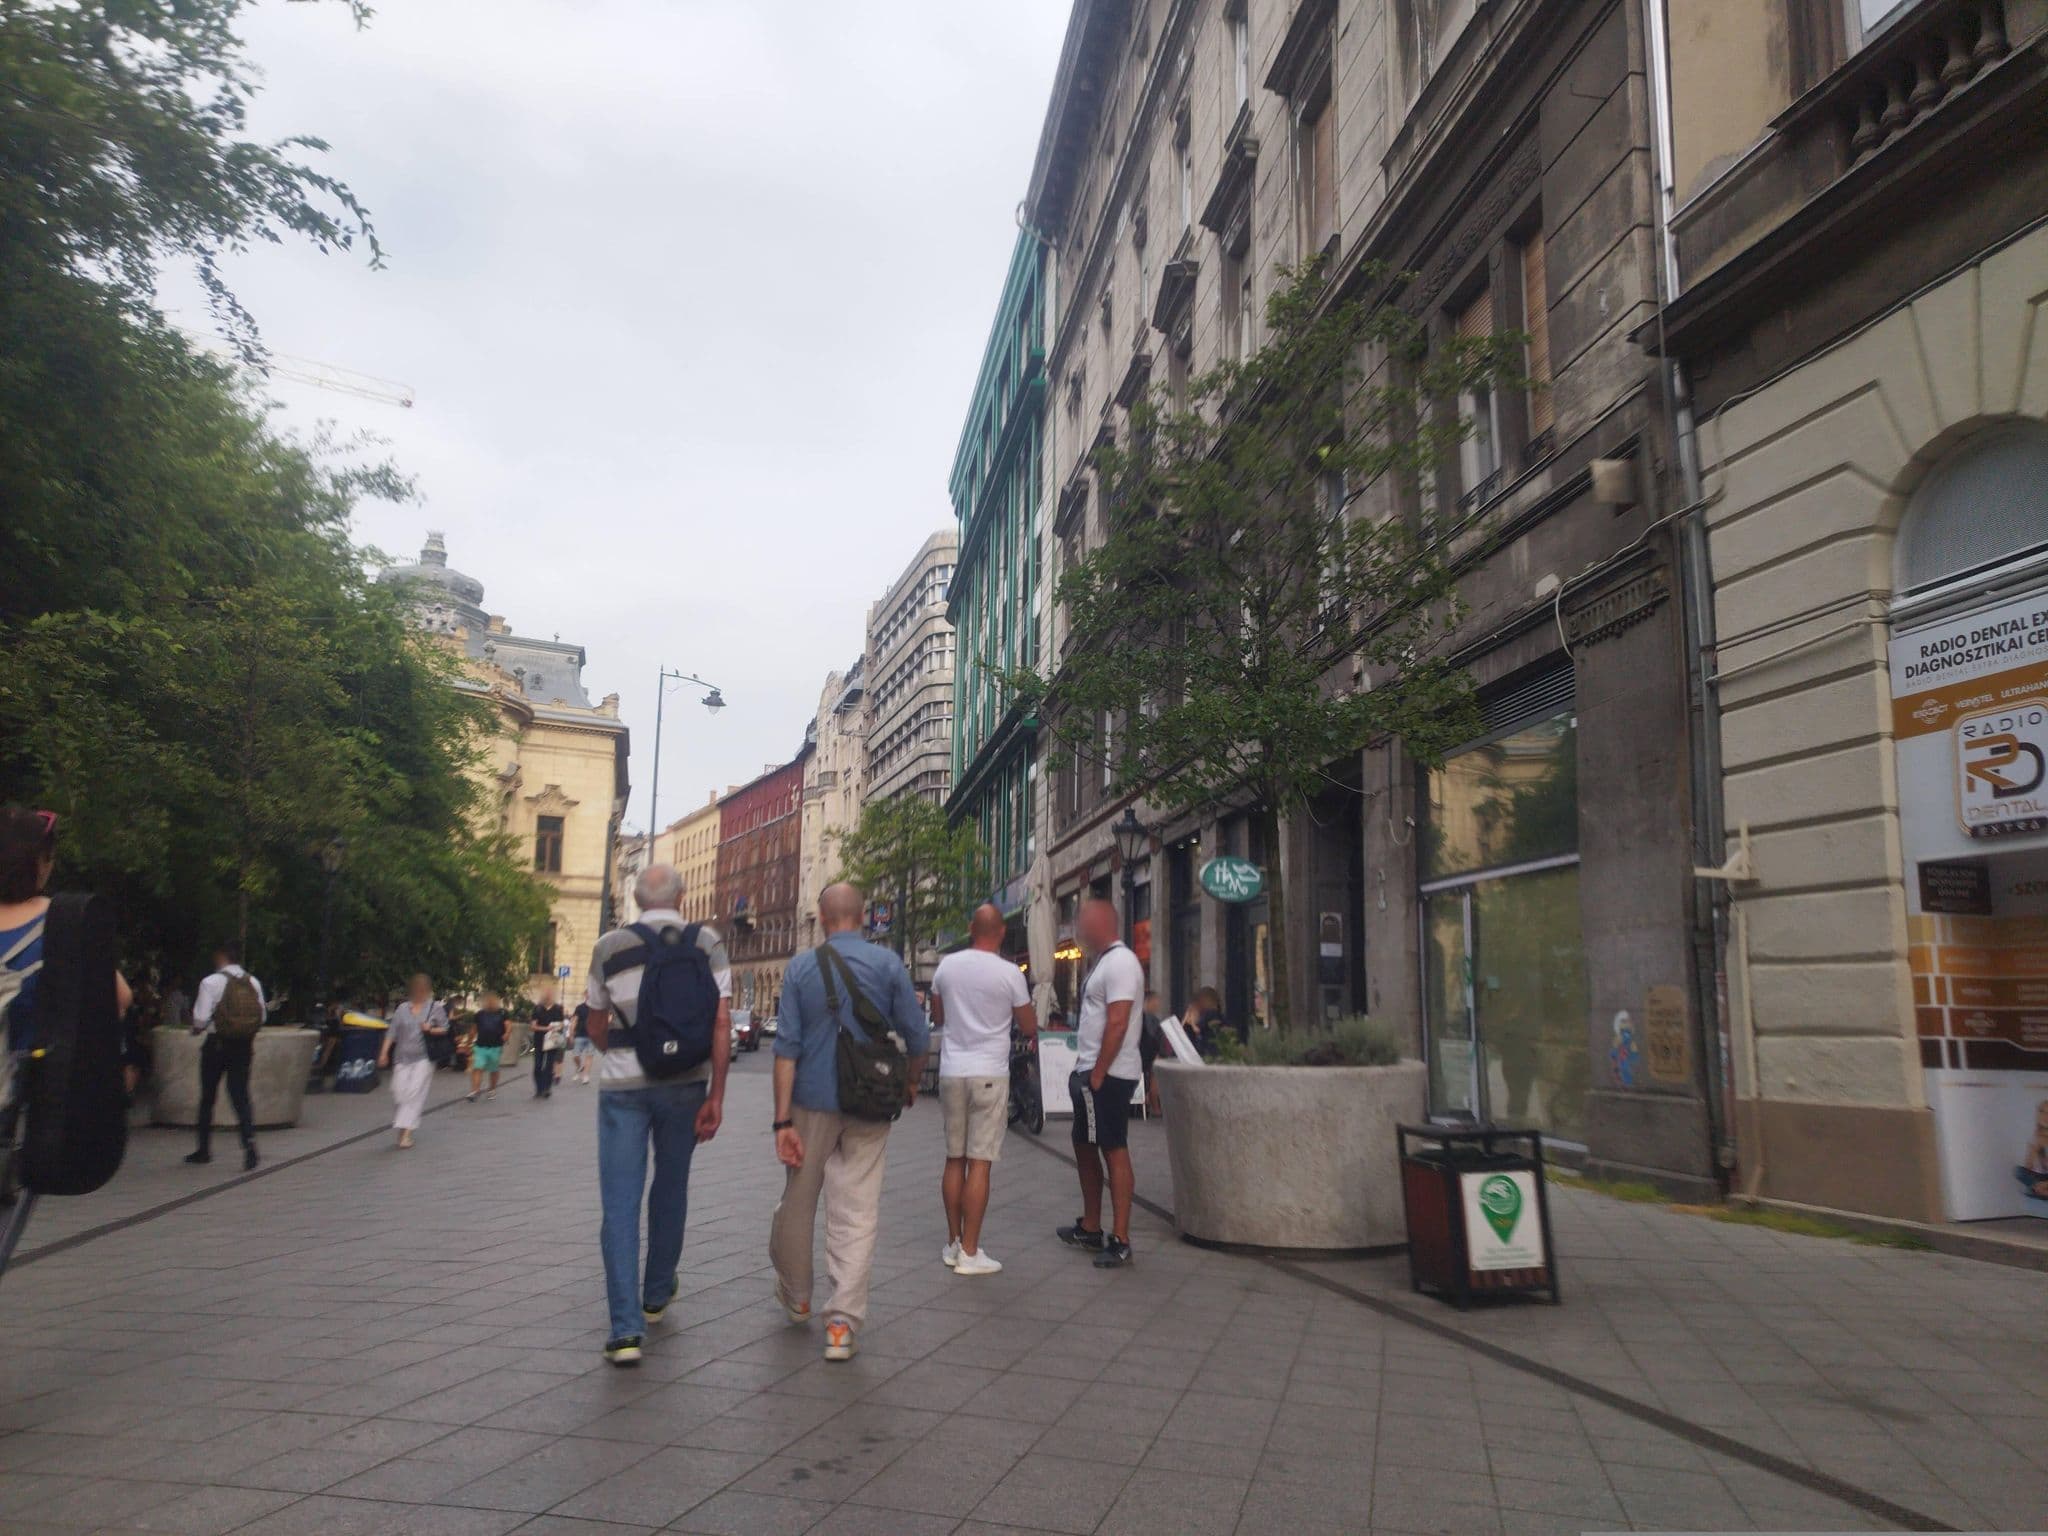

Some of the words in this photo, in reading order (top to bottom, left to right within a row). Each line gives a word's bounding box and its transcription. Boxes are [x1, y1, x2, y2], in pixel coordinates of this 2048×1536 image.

[1905, 635, 2023, 679] DIAGNOSZTIKAI
[1920, 634, 1967, 658] RADIO
[1971, 617, 2028, 645] DENTAL
[1963, 711, 2042, 738] RADIO
